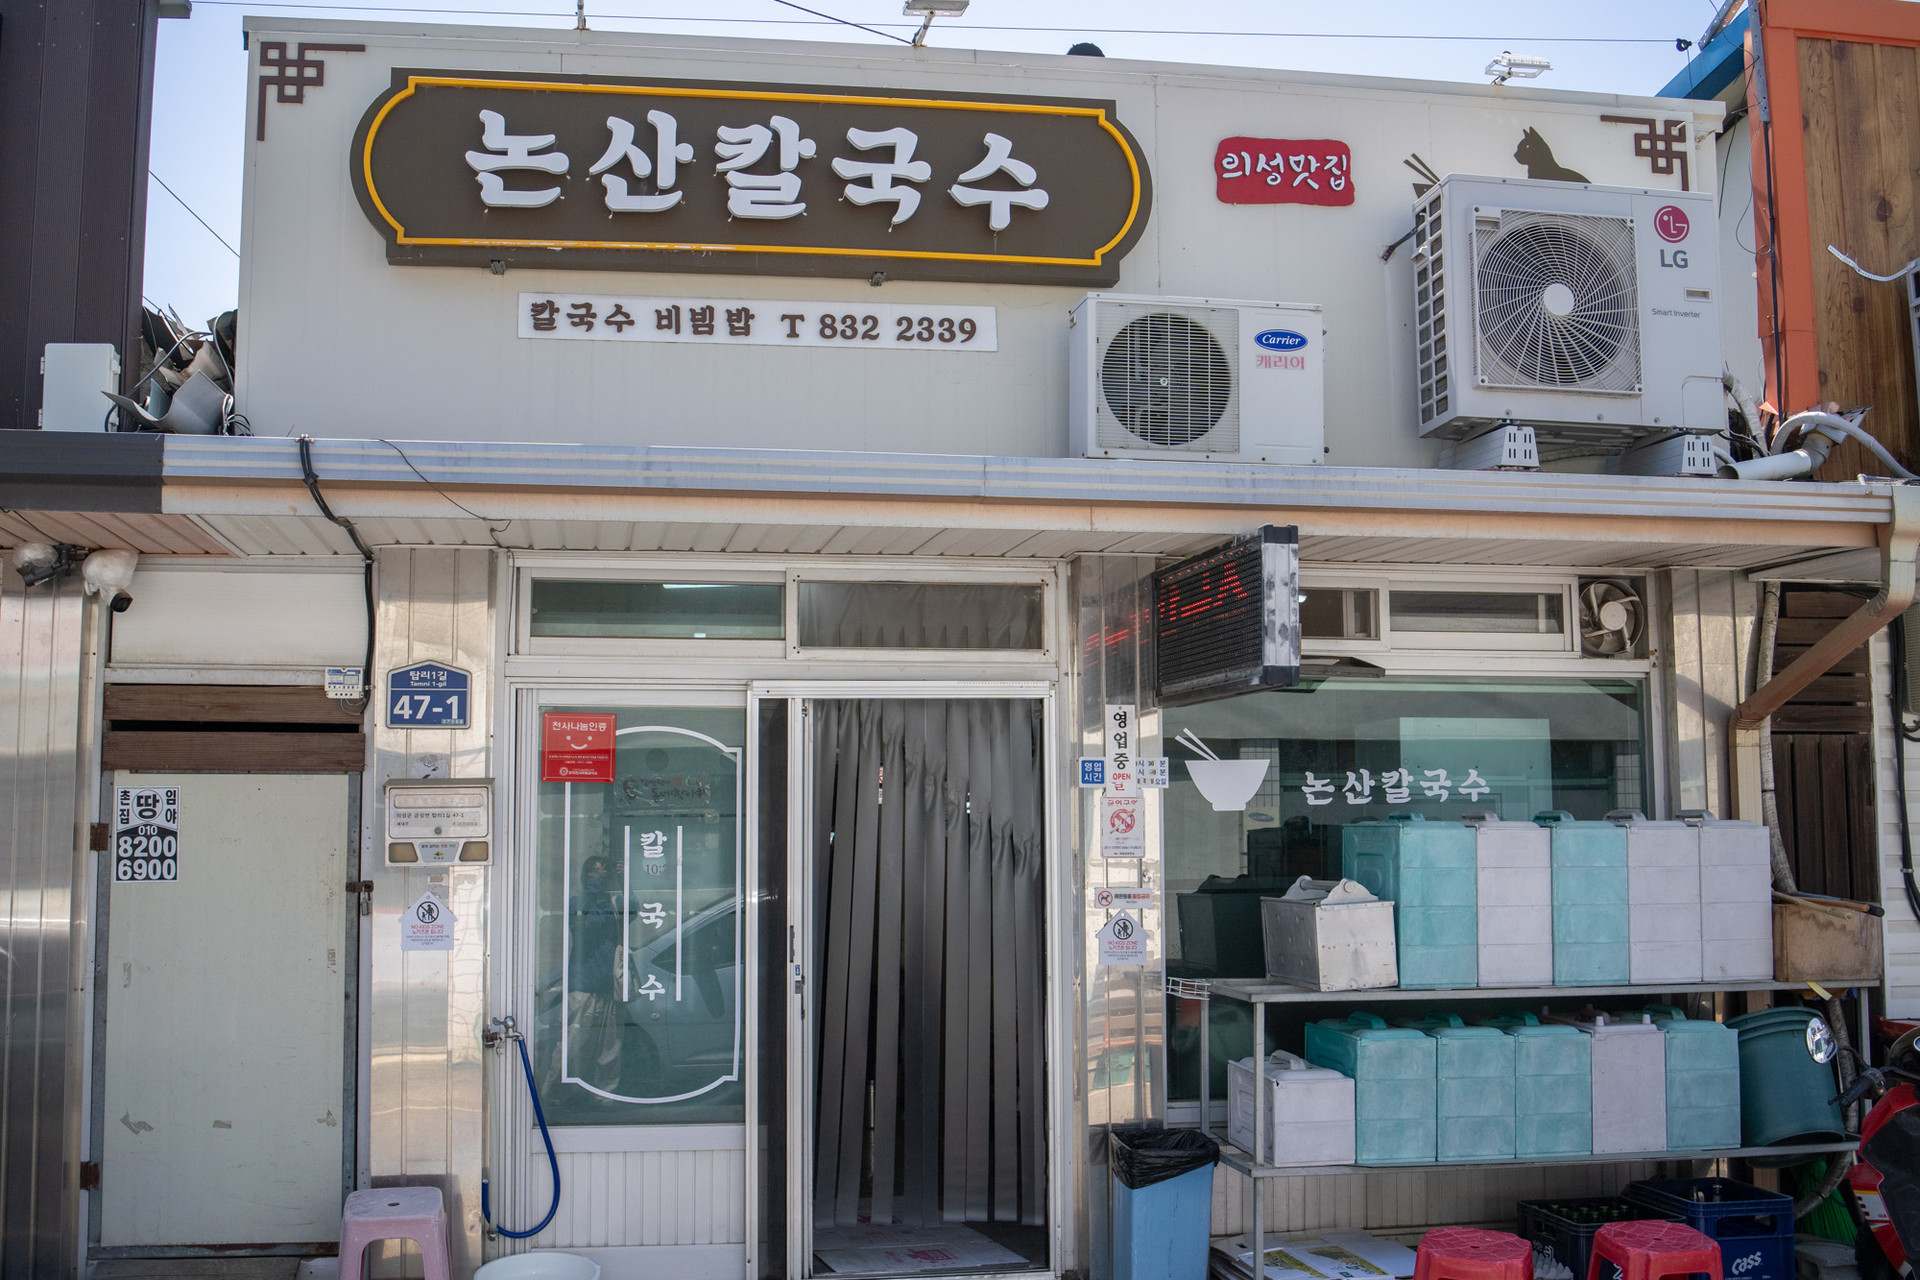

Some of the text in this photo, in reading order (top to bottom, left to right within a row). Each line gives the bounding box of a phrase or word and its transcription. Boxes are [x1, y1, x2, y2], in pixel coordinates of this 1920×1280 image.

[465, 108, 1049, 232] 논산칼국수
[1221, 151, 1347, 191] 의성맛집
[1660, 248, 1688, 269] LG
[530, 299, 977, 344] 칼국수 비빔밥 T 832 2339
[1652, 308, 1700, 319] Smart Inverter
[1262, 334, 1301, 346] Carrier
[1256, 354, 1304, 370] 캐리어
[409, 670, 447, 681] 탑리1길
[393, 695, 459, 719] 47-1
[552, 721, 607, 732] 천사나눔인증
[1113, 711, 1130, 770] 영업중
[1084, 762, 1102, 772] 영업
[1084, 772, 1102, 782] 시간
[1301, 768, 1490, 805] 논산칼국수
[119, 789, 130, 824] 촌집
[136, 794, 160, 819] 땅
[165, 789, 177, 824] 임야
[138, 825, 158, 836] 010
[118, 836, 177, 858] 8200
[118, 859, 177, 880] 6900
